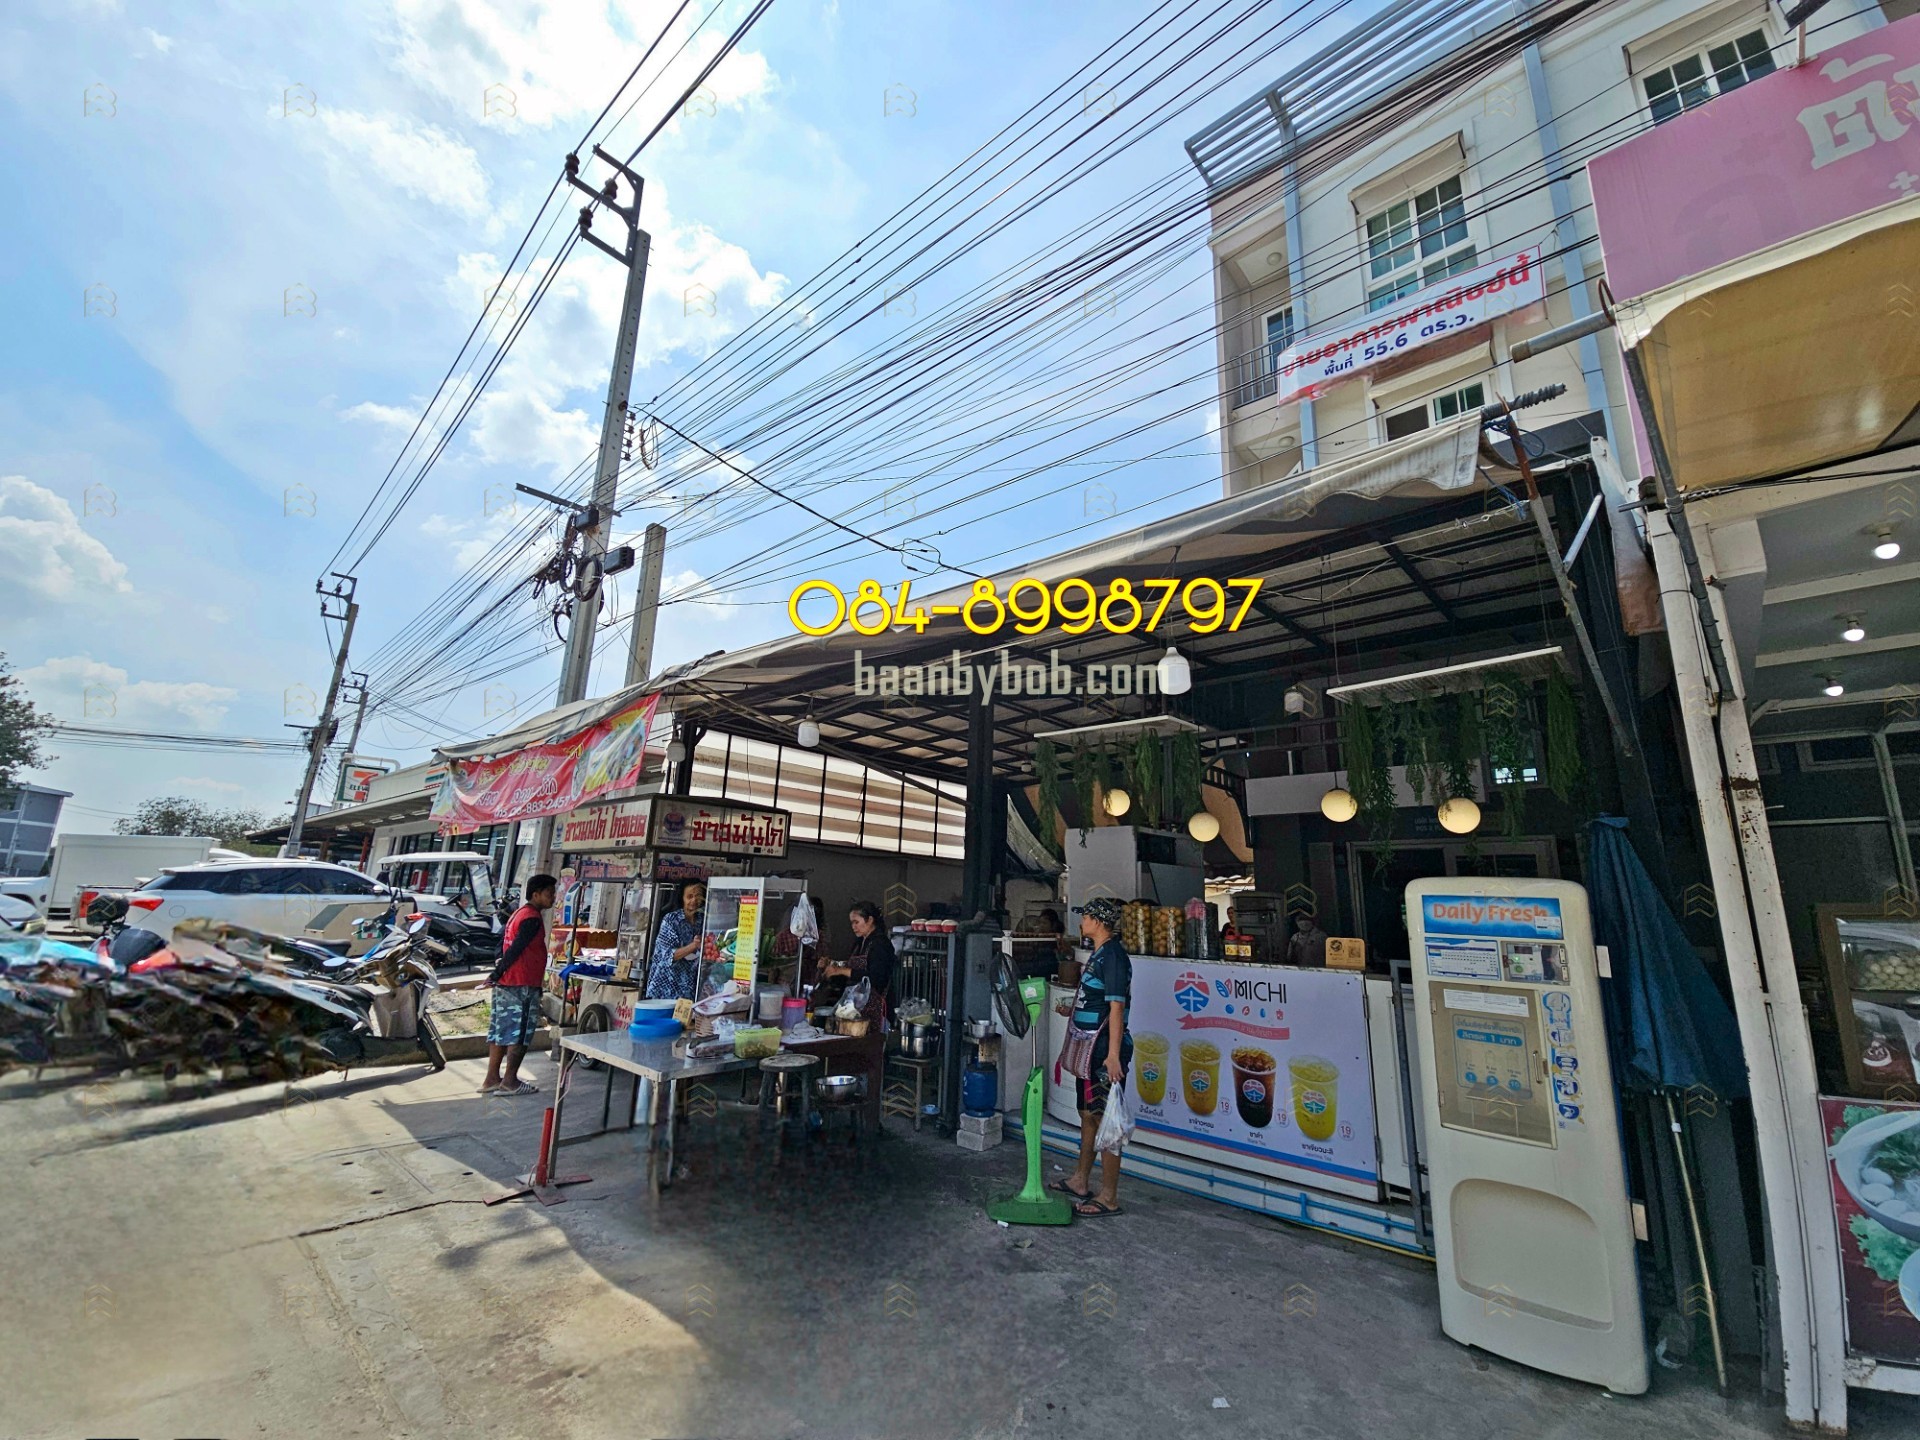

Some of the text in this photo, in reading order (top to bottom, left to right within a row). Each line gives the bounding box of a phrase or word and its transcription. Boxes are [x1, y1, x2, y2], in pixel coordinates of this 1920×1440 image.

[1324, 314, 1475, 376] พื้นที่ 55.6 ตร.ว.
[692, 810, 784, 847] ข้าวมันไก่
[1433, 902, 1548, 924] Daily Fresh
[1234, 979, 1287, 1004] MICHI
[1168, 1091, 1177, 1100] 19
[1221, 1101, 1230, 1111] 19
[1277, 1112, 1287, 1121] 19
[1341, 1125, 1352, 1135] 19
